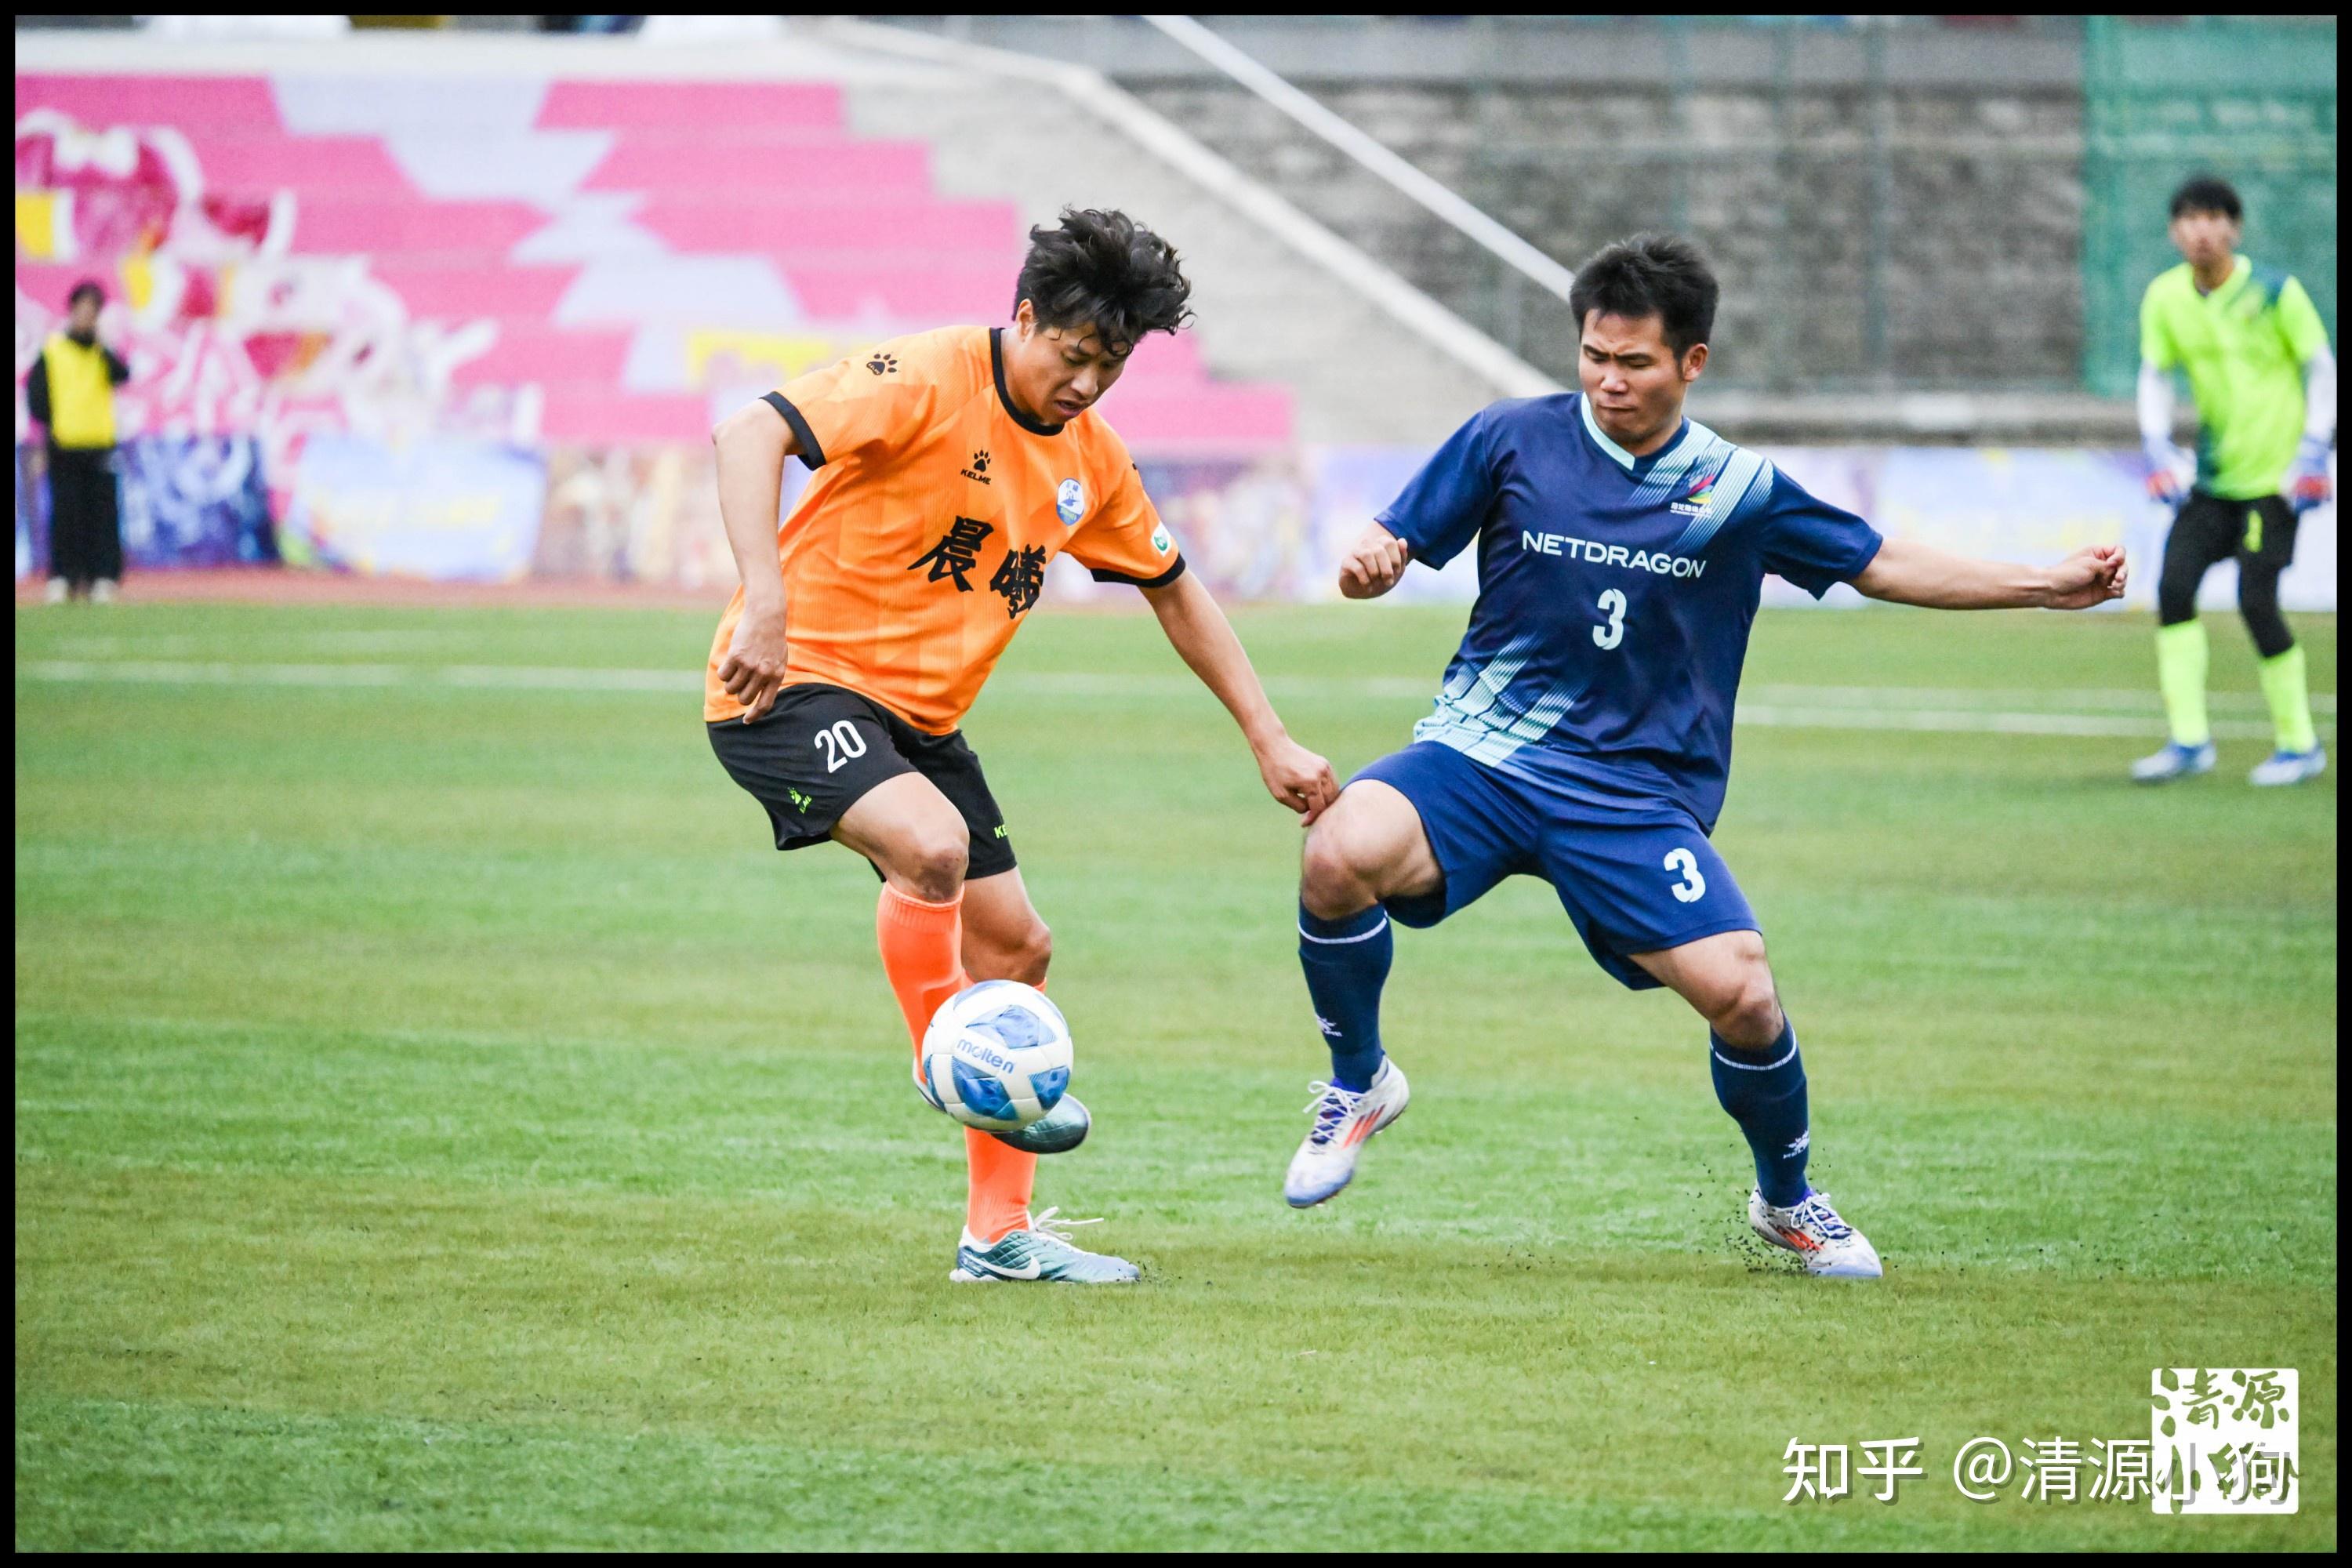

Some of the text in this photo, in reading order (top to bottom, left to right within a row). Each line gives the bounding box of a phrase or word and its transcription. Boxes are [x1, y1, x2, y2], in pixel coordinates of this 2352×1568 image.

[960, 469, 991, 485] KELME
[1523, 530, 1707, 579] NETDRAGON
[1592, 588, 1627, 650] 3
[815, 720, 866, 773] 20
[1664, 848, 1706, 902] 3
[957, 1039, 1014, 1073] molten
